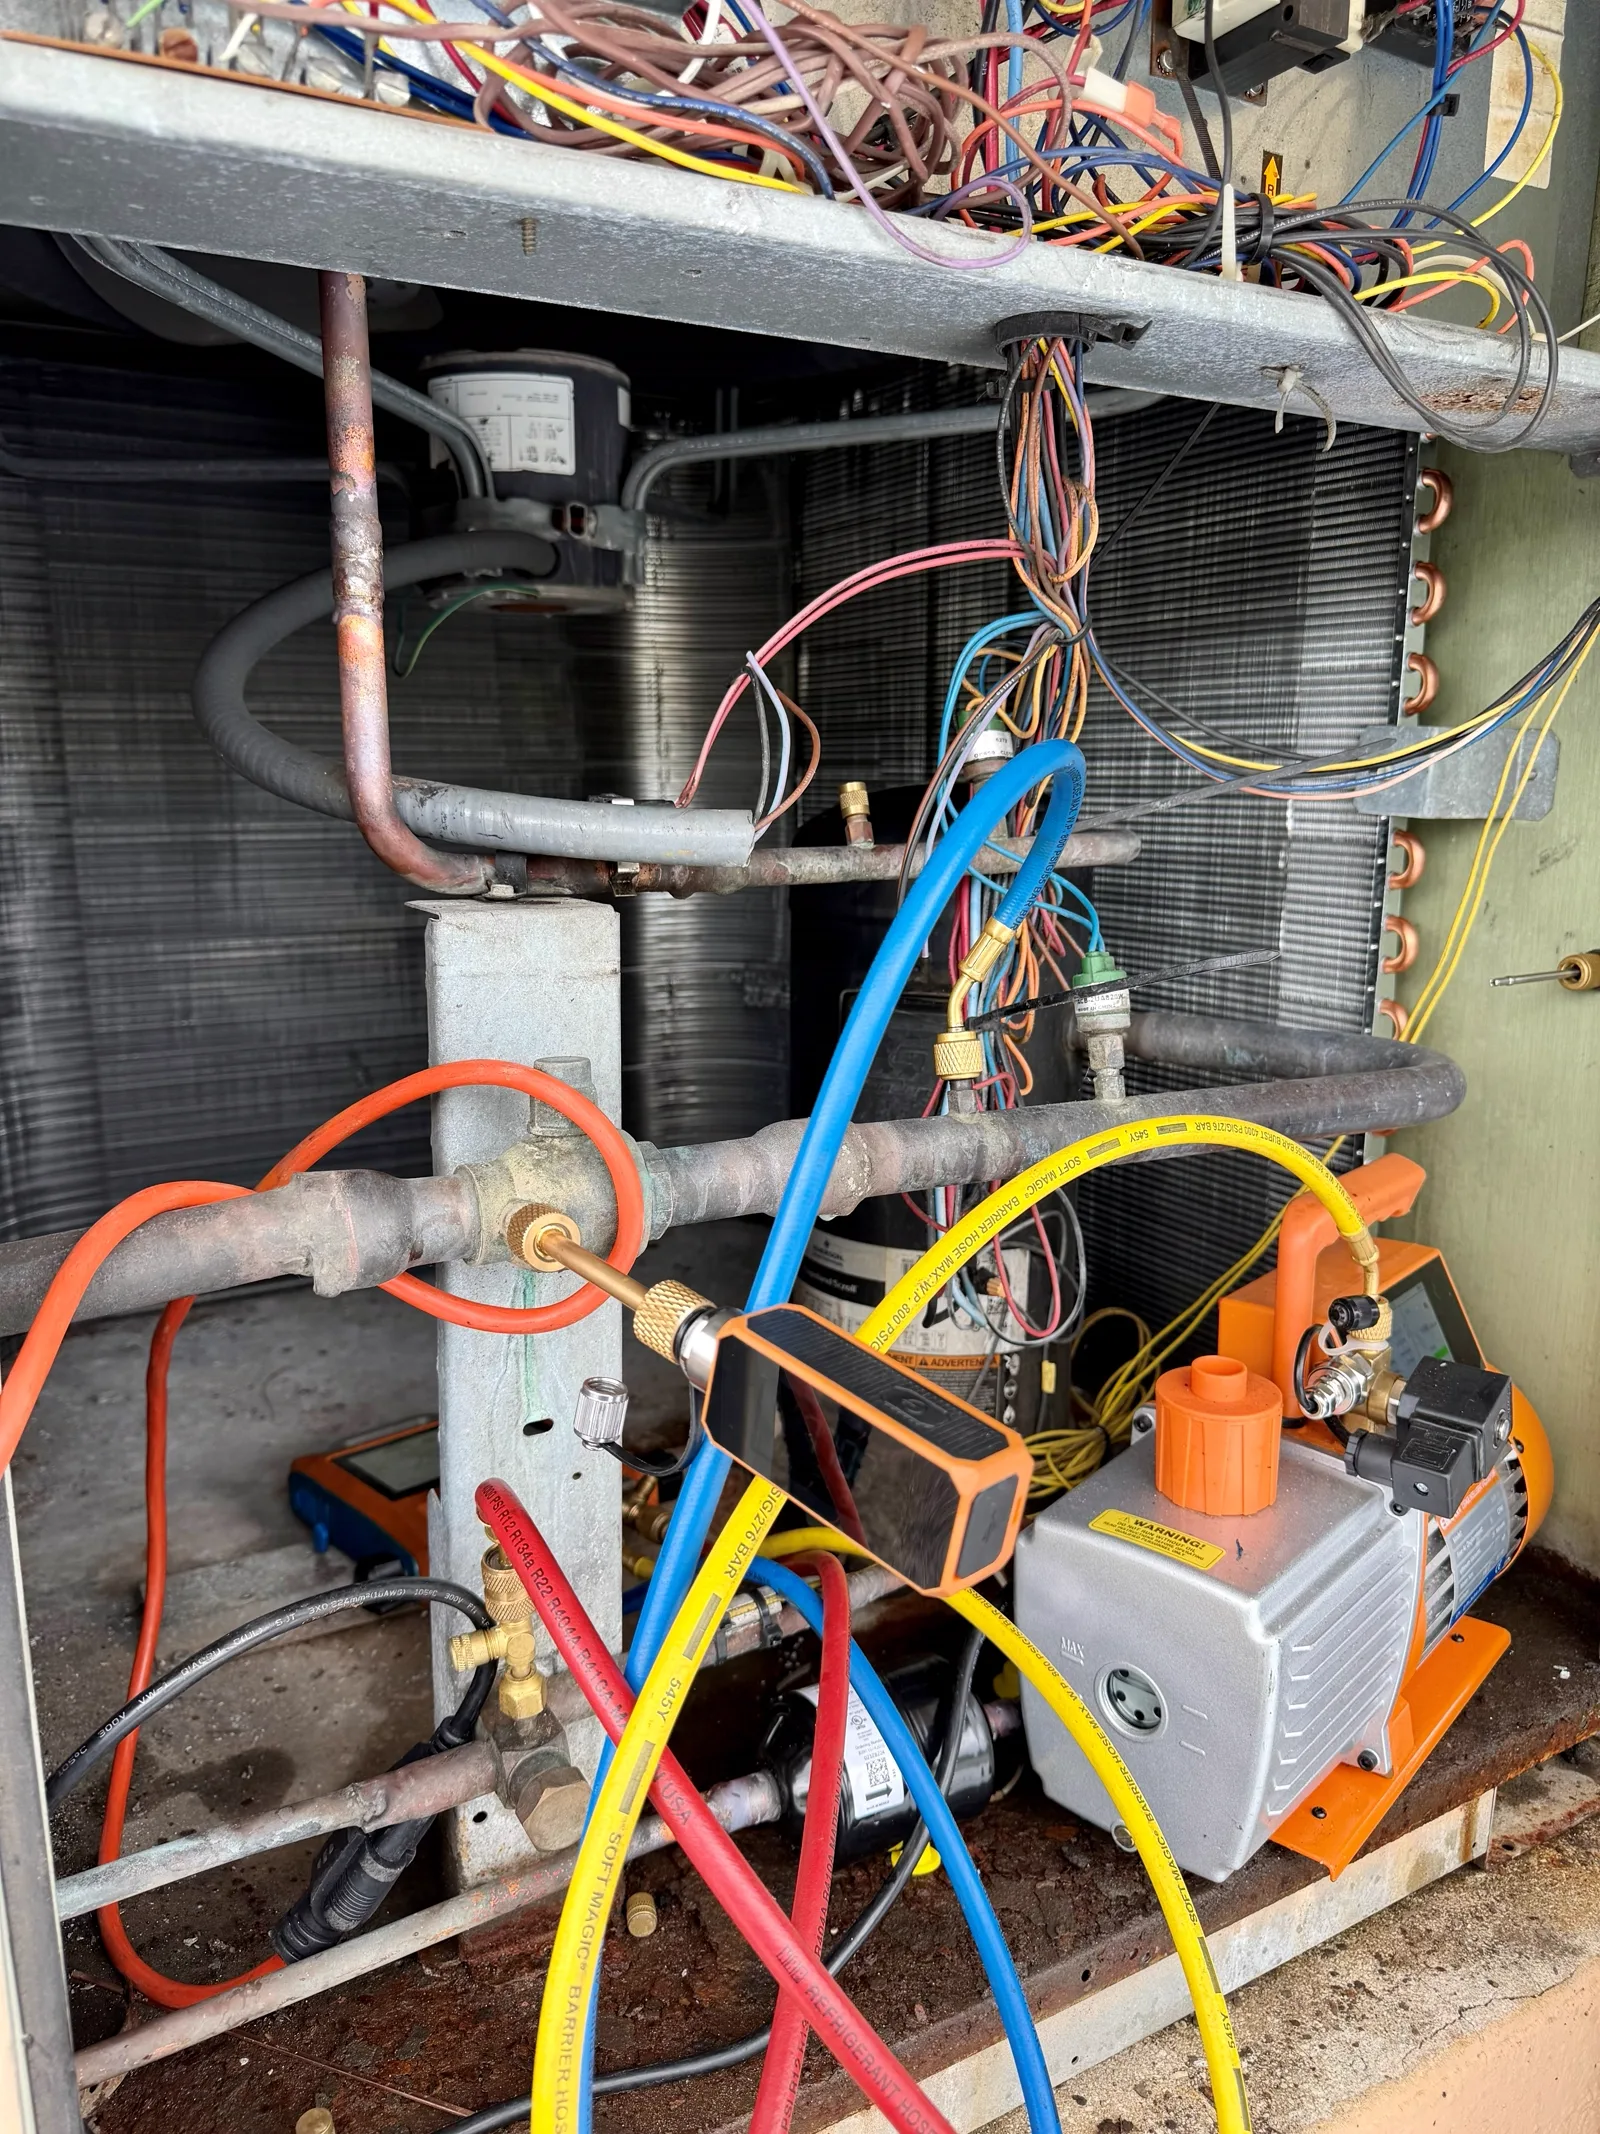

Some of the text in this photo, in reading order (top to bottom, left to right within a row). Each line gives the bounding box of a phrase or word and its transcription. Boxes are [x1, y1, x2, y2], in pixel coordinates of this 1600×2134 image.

[1267, 184, 1274, 195] R
[1057, 834, 1070, 850] 800
[1026, 885, 1043, 908] BAR
[1129, 1129, 1149, 1143] 545Y
[1195, 1121, 1211, 1132] BAR
[1212, 1122, 1243, 1134] PSIG/276
[1243, 1125, 1260, 1136] 4000
[1260, 1130, 1281, 1146] BURST
[1280, 1137, 1295, 1152] BAR
[1062, 1155, 1082, 1175] SOFT
[978, 1195, 1021, 1234] BARRIER
[955, 1230, 980, 1260] HOSE
[892, 1303, 912, 1325] 800
[931, 1357, 998, 1368] ADVERTENA
[489, 1496, 506, 1514] PSI
[497, 1509, 516, 1533] R12
[509, 1529, 535, 1571] R134a
[1103, 1521, 1205, 1561] READ INSTRUCTIONS BEFORE OPERATING
[1114, 1528, 1186, 1557] QUALIFIED PERSONNEL ONLY
[1127, 1524, 1141, 1532] NOT
[1141, 1529, 1155, 1537] RUN
[1155, 1535, 1185, 1549] WITHOUT
[1133, 1518, 1206, 1550] WARNING!
[724, 1541, 750, 1580] BAR
[530, 1567, 554, 1599] R22
[547, 1596, 583, 1651] R404A
[991, 1608, 1012, 1628] BAR
[1010, 1627, 1042, 1660] PSIG/55
[1061, 1636, 1085, 1658] MAX
[97, 1712, 127, 1739] 300V
[137, 1682, 170, 1711] VW-1
[444, 1592, 465, 1605] 300V
[576, 1647, 616, 1709] R410A
[1043, 1661, 1060, 1677] 800
[656, 1676, 683, 1723] 545Y
[1097, 1731, 1122, 1764] HOSE
[836, 1757, 845, 1789] USA
[660, 1782, 693, 1827] USA
[834, 1789, 842, 1807] IN
[1119, 1766, 1154, 1822] BARRIER
[828, 1808, 839, 1851] MADE
[596, 1832, 622, 1891] SOFT
[822, 1854, 835, 1903] R410A
[1177, 1883, 1199, 1925] SOFT
[814, 1906, 828, 1957] R404A
[557, 1984, 583, 2083] BARRIER
[804, 1983, 901, 2100] REFRIGERANT
[1221, 2013, 1236, 2050] 545Y
[789, 2058, 801, 2096] R12
[780, 2101, 794, 2132] PSI
[896, 2097, 937, 2134] HOS
